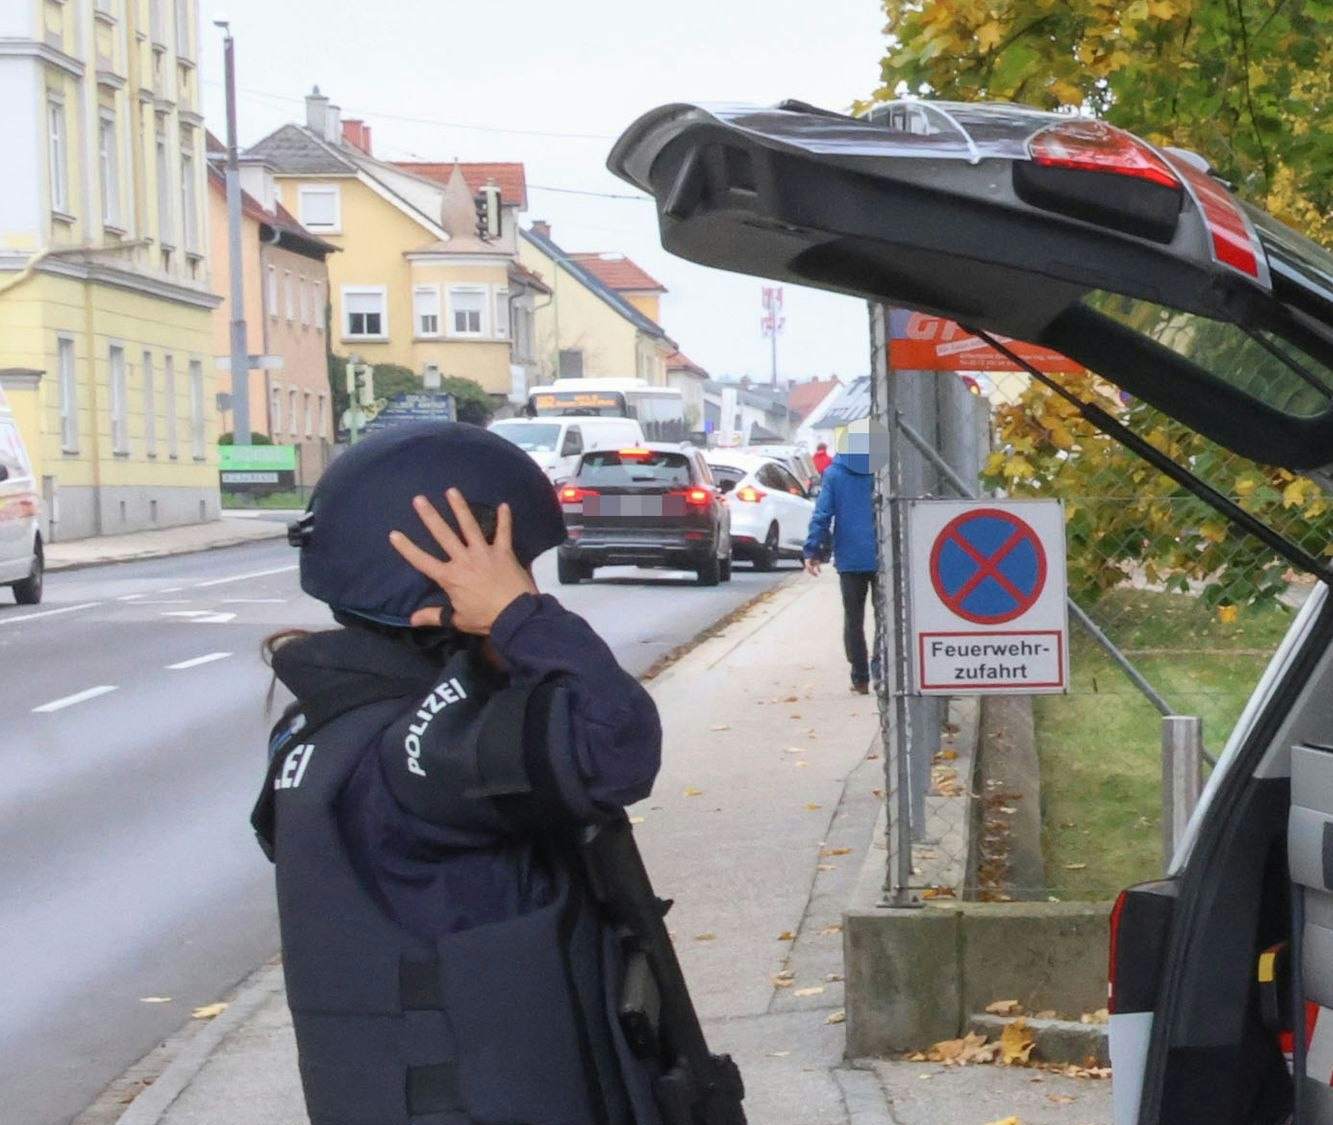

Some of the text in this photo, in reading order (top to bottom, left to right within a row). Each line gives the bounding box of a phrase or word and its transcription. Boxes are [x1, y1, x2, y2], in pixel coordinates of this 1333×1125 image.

[931, 641, 1050, 657] Feuerwehr-
[954, 664, 1027, 679] zufahrt
[405, 677, 467, 777] POLIZEI
[274, 744, 315, 790] EI
